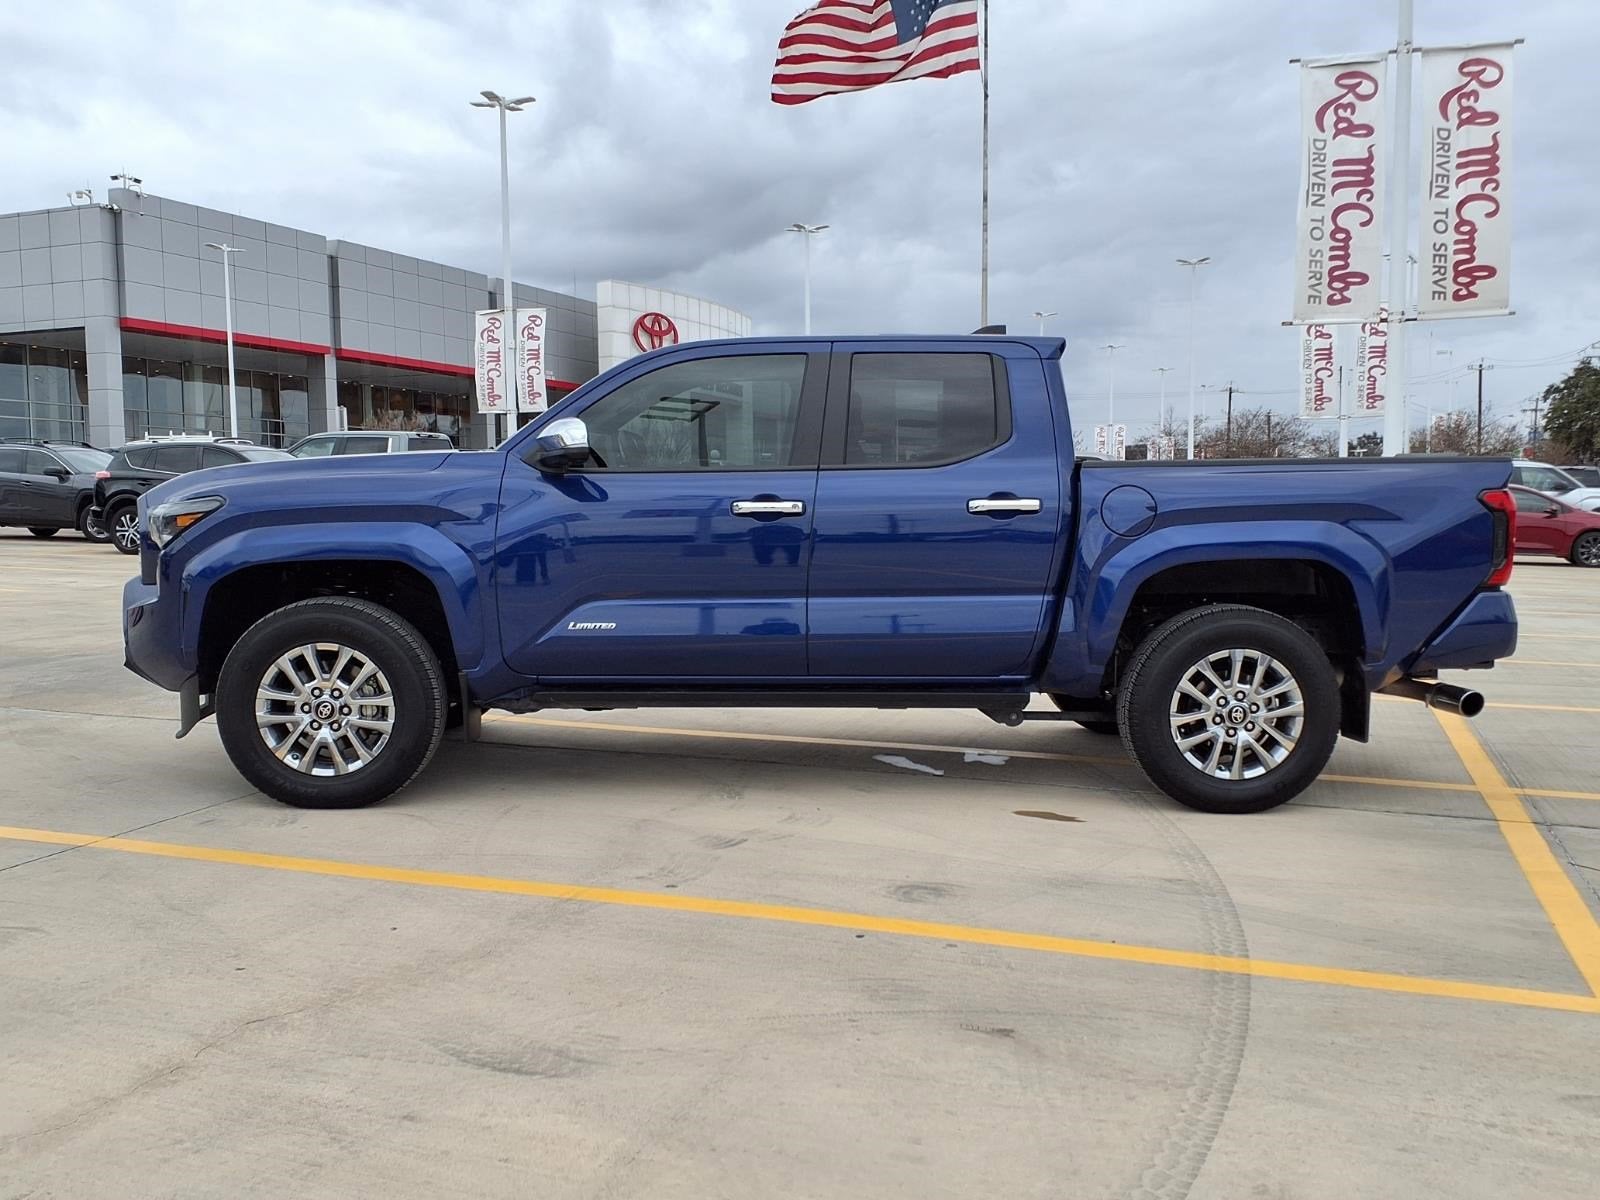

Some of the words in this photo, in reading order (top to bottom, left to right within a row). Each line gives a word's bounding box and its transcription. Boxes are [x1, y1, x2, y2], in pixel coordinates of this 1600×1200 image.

[1315, 70, 1379, 140] Red
[1438, 57, 1504, 131] Red
[1310, 138, 1327, 208] DRIVEN
[1434, 127, 1451, 199] DRIVEN
[1309, 216, 1325, 241] TO
[1327, 143, 1376, 306] McCombs
[1432, 208, 1449, 234] TO
[1452, 131, 1501, 302] McCombs
[1307, 249, 1325, 305] SERVE
[1431, 242, 1448, 301] SERVE
[480, 316, 502, 344] Red
[521, 314, 543, 342] Red
[1304, 339, 1312, 370] DRIVEN
[1306, 324, 1333, 340] ed
[479, 373, 485, 382] TO
[486, 346, 502, 407] McCombs
[520, 371, 526, 380] TO
[526, 344, 542, 405] McCombs
[1305, 374, 1312, 384] TO
[1314, 342, 1334, 412] McCombs
[1358, 371, 1365, 381] TO
[1366, 340, 1388, 410] McCombs
